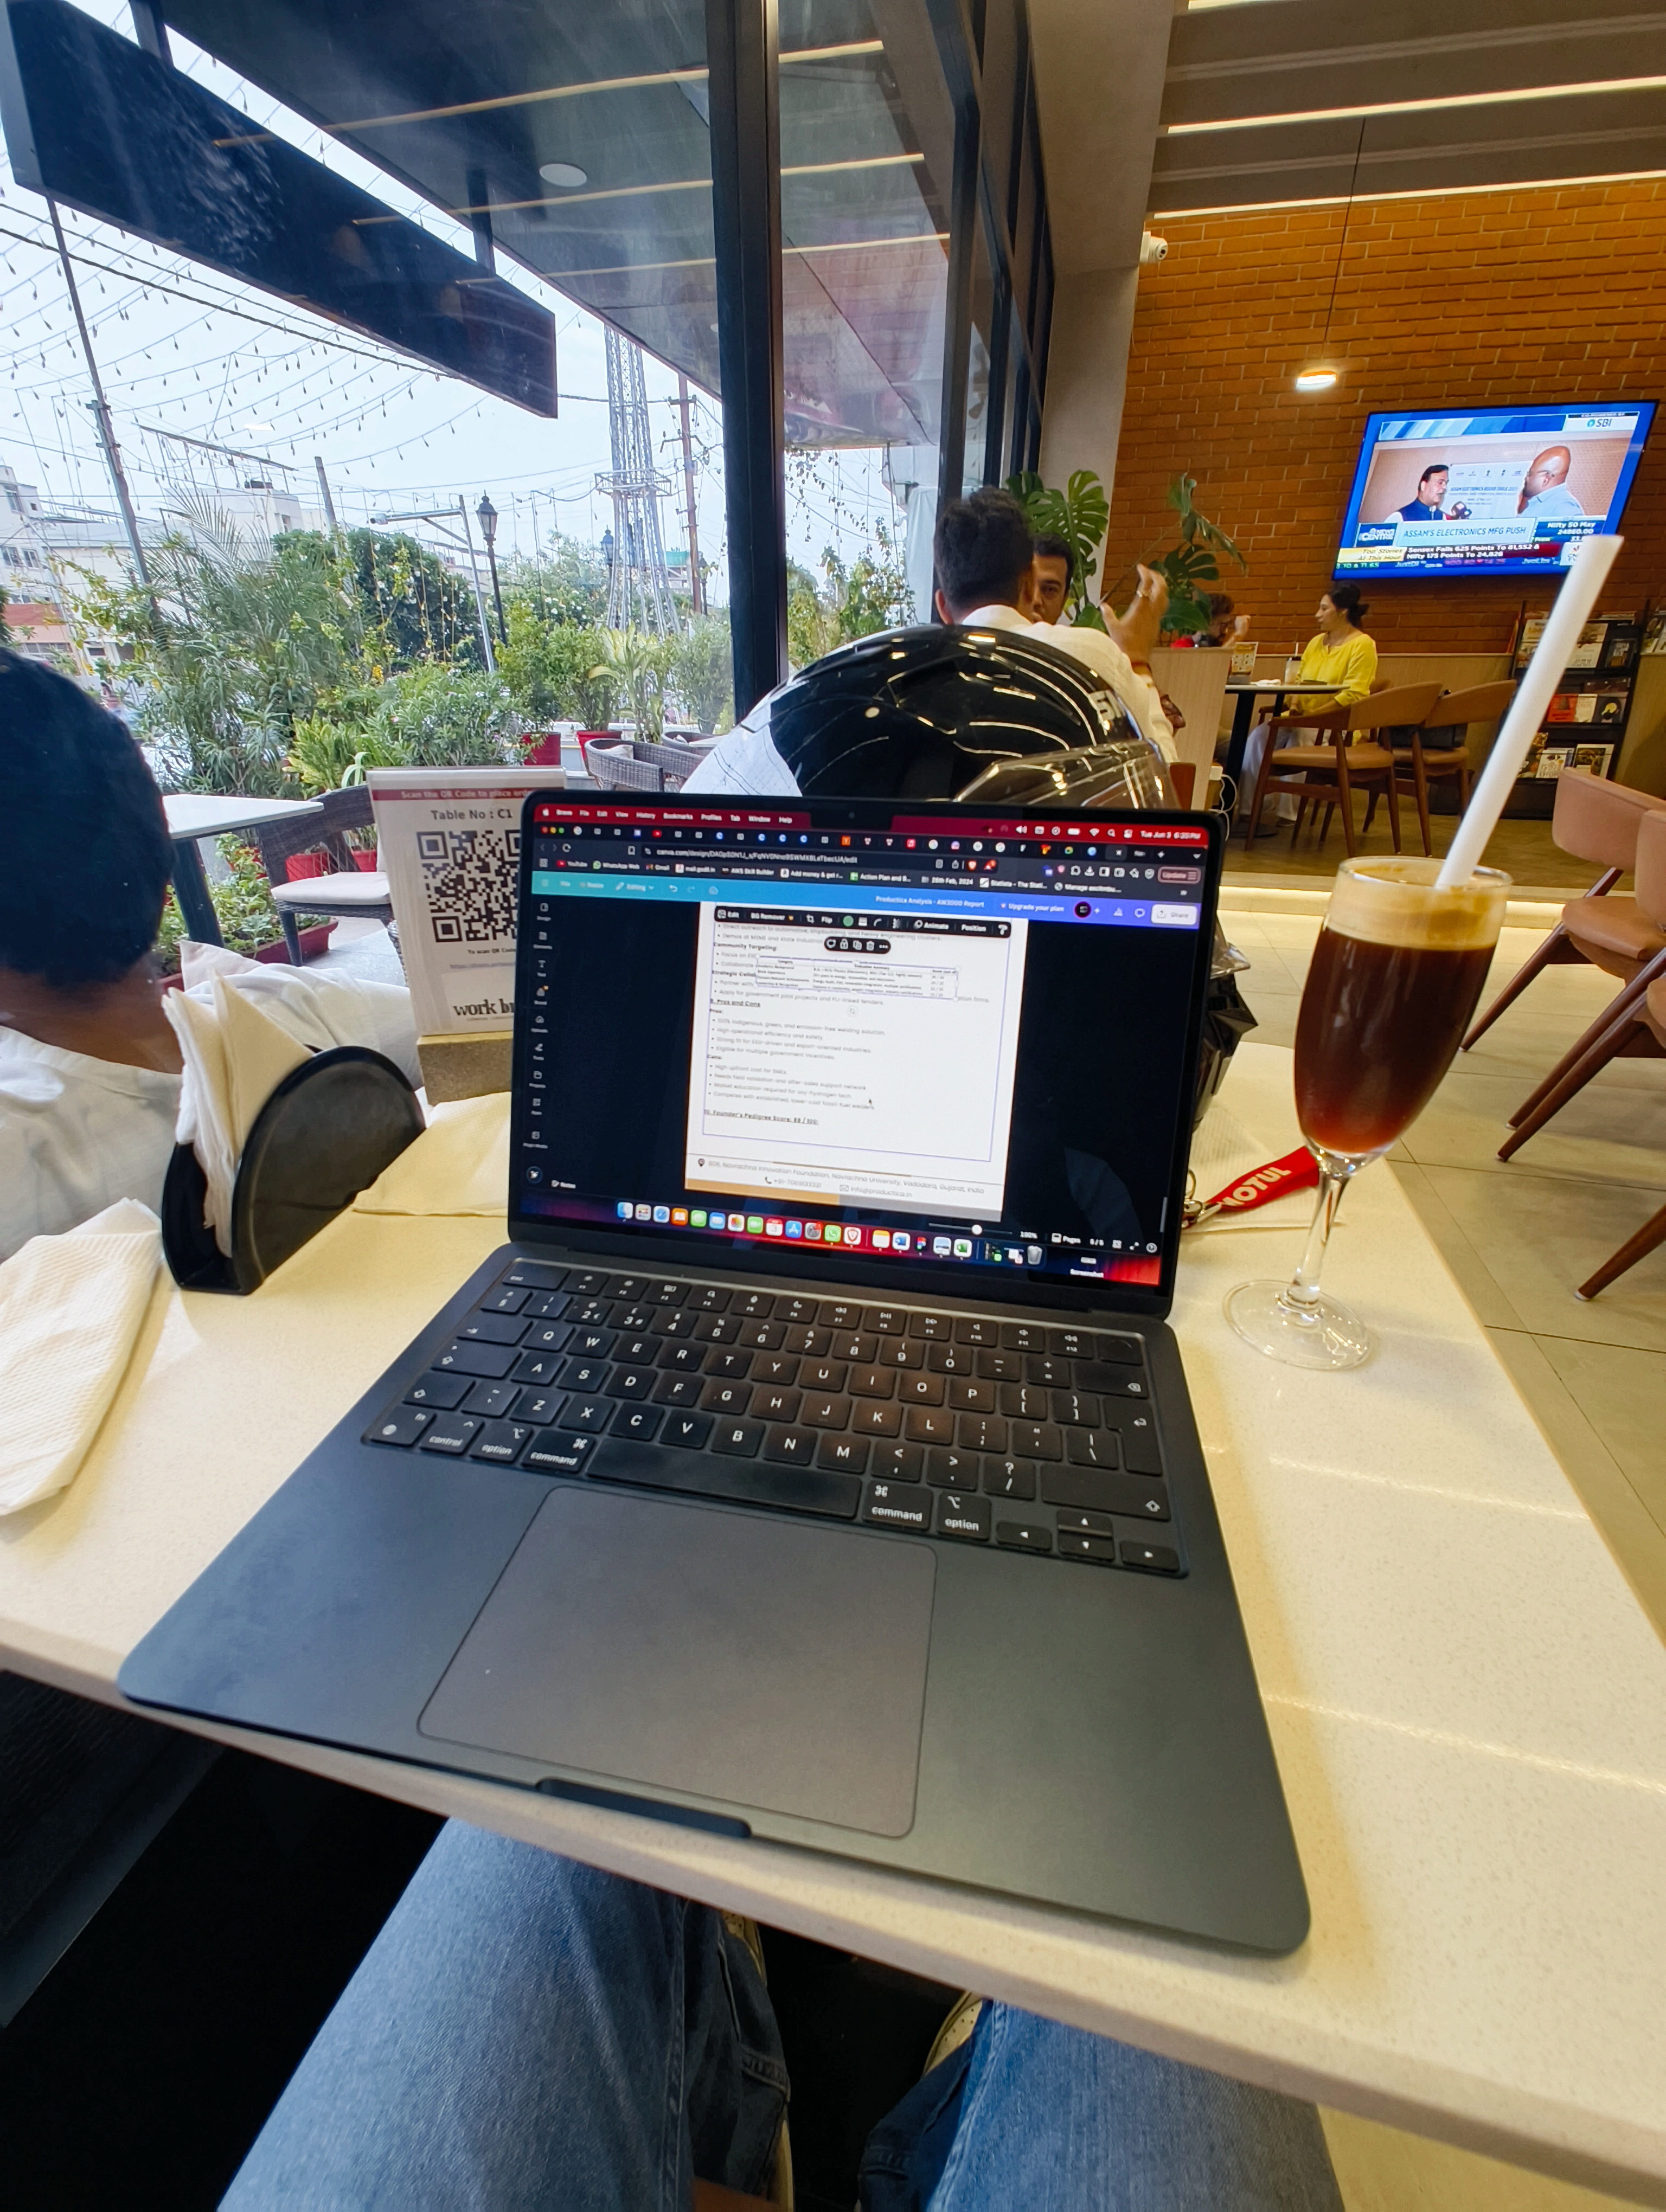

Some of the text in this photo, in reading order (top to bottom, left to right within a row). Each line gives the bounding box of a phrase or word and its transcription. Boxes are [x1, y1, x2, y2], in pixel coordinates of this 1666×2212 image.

[1595, 419, 1612, 427] SBI
[1404, 529, 1434, 537] ASSAM'S
[1437, 528, 1486, 536] ELECTRONICS
[401, 790, 421, 799] Scan
[440, 790, 453, 798] QR
[489, 789, 511, 799] place
[431, 809, 465, 820] Table
[469, 809, 486, 819] No
[497, 809, 513, 819] C1
[636, 812, 656, 820] History
[778, 816, 793, 824] Help
[1162, 871, 1187, 879] Update
[908, 897, 932, 905] Analysis
[964, 900, 984, 908] Report
[1008, 902, 1035, 911] Upgrade
[1050, 905, 1065, 913] plan
[727, 910, 740, 918] Edit
[760, 912, 785, 921] Remover
[821, 915, 833, 924] Flip
[923, 922, 949, 930] Animate
[960, 923, 987, 932] Position
[453, 999, 497, 1016] work
[581, 1310, 592, 1319] 2
[624, 1316, 634, 1325] 3
[668, 1322, 677, 1331] 4
[542, 1330, 554, 1341] Q
[586, 1336, 600, 1348] W
[804, 1339, 812, 1349] 7
[631, 1343, 643, 1353] E
[676, 1349, 688, 1359] R
[898, 1352, 906, 1362] 9
[725, 1355, 734, 1366] T
[945, 1358, 955, 1368] 0
[531, 1363, 542, 1373] A
[772, 1362, 781, 1372] Y
[578, 1369, 590, 1380] S
[818, 1368, 829, 1379] U
[624, 1376, 637, 1386] D
[673, 1383, 684, 1393] F
[917, 1382, 927, 1393] O
[721, 1390, 732, 1401] G
[967, 1388, 978, 1399] P
[532, 1399, 546, 1411] Z
[770, 1397, 783, 1409] H
[580, 1407, 594, 1418] X
[821, 1405, 831, 1416] J
[630, 1414, 643, 1426] C
[873, 1411, 883, 1423] K
[682, 1422, 694, 1434] V
[926, 1419, 934, 1431] L
[428, 1436, 463, 1447] control
[732, 1430, 744, 1442] B
[784, 1437, 797, 1450] N
[482, 1444, 512, 1455] option
[836, 1445, 850, 1458] M
[530, 1452, 578, 1466] command
[871, 1506, 923, 1522] command
[944, 1518, 979, 1532] option
